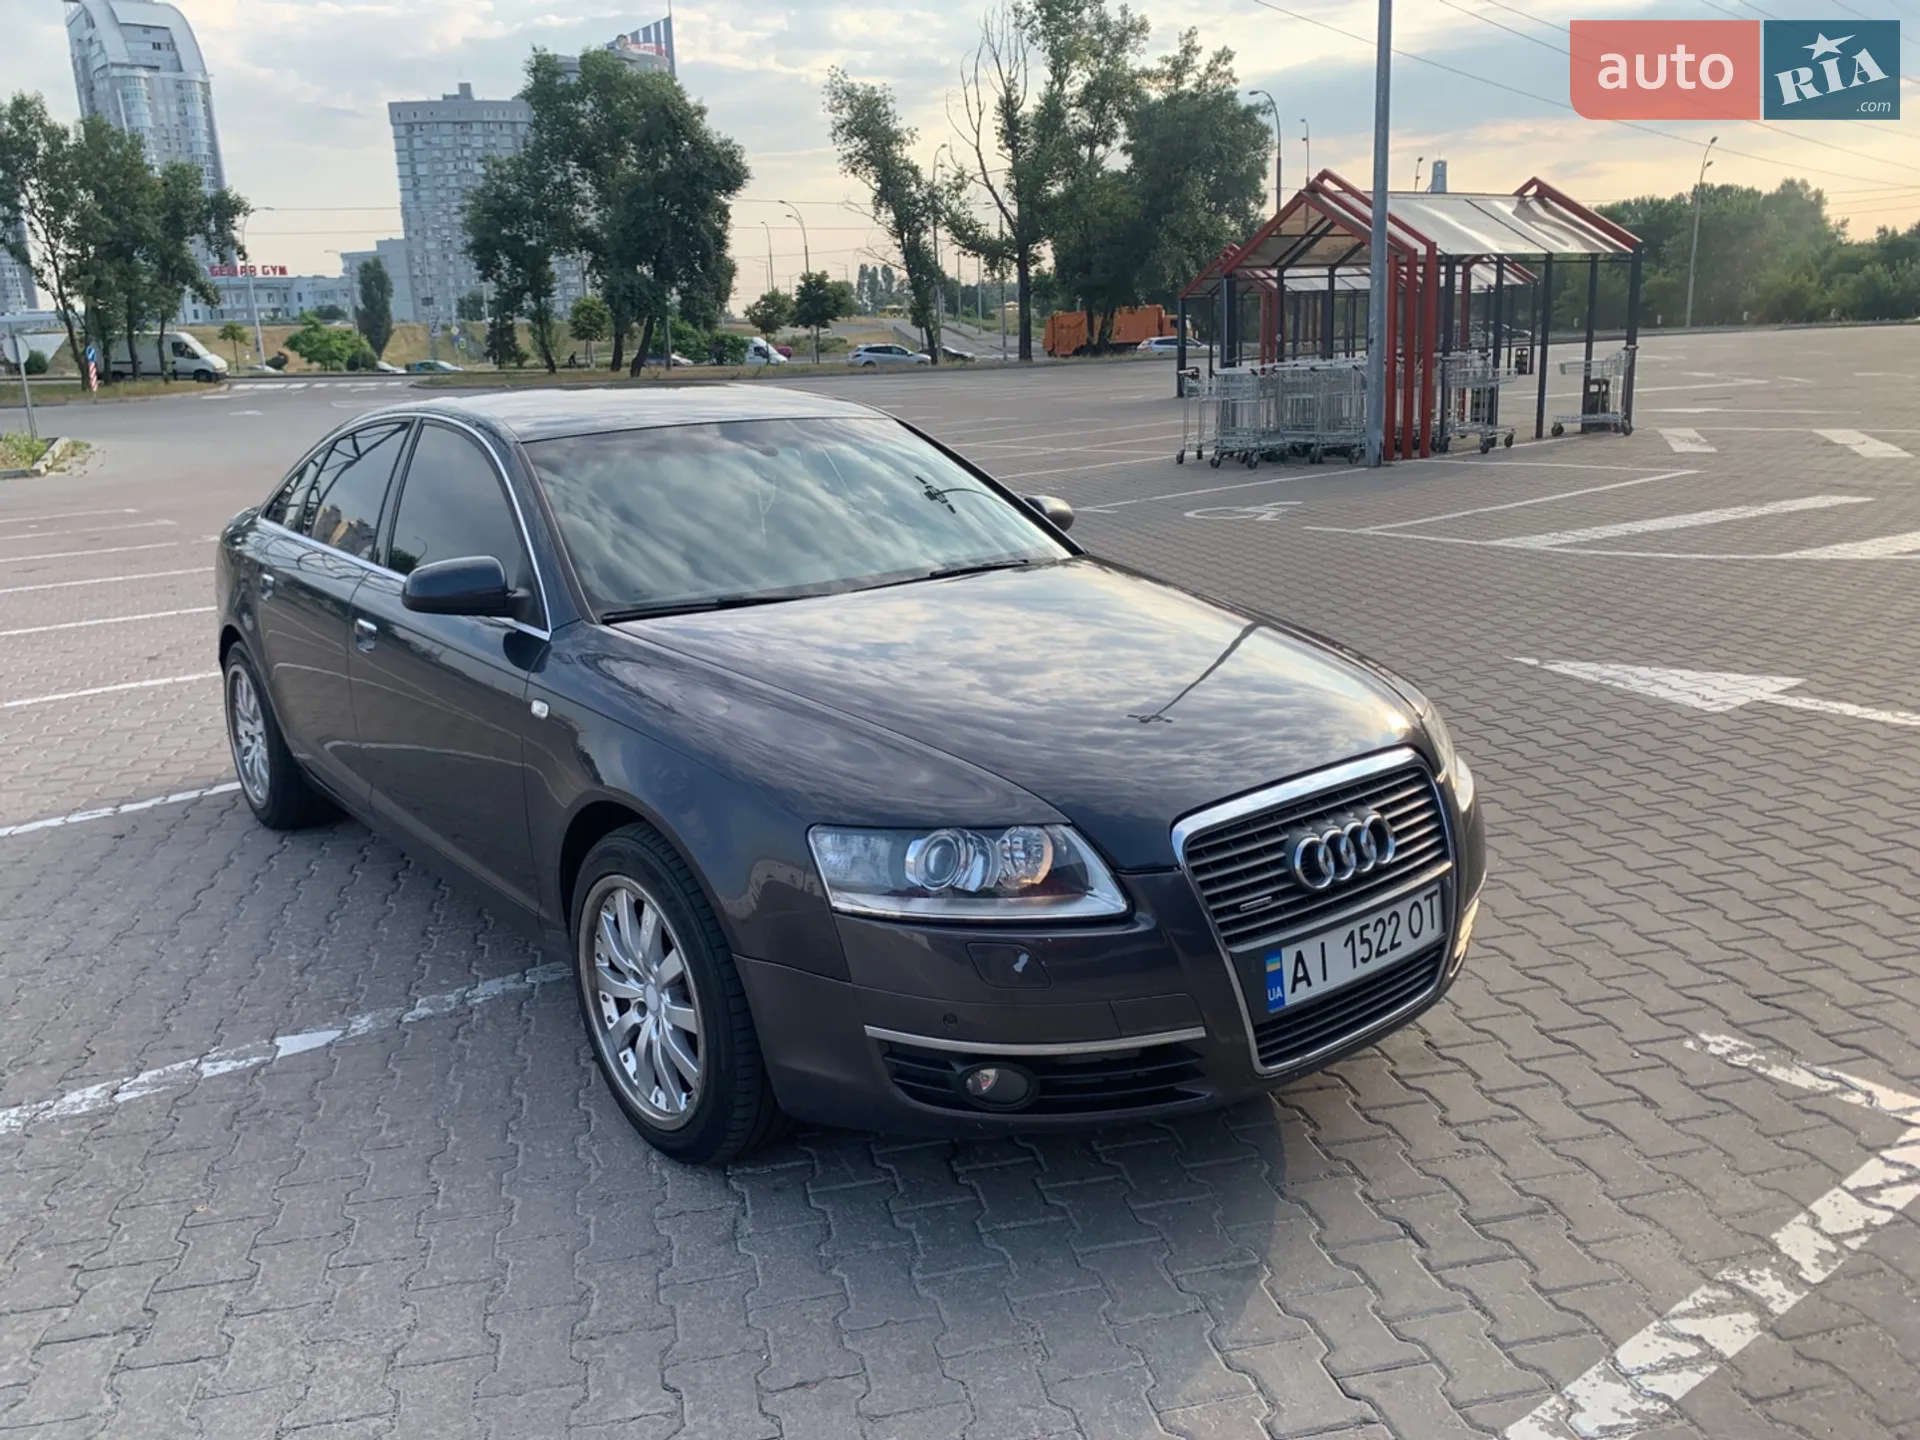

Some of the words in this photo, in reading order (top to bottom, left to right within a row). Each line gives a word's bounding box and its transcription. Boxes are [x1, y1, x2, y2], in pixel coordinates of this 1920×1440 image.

[261, 265, 288, 276] GYM
[1290, 942, 1328, 994] AI
[1343, 910, 1402, 970] 1522
[1407, 890, 1439, 940] OT
[1268, 985, 1283, 1002] UA
